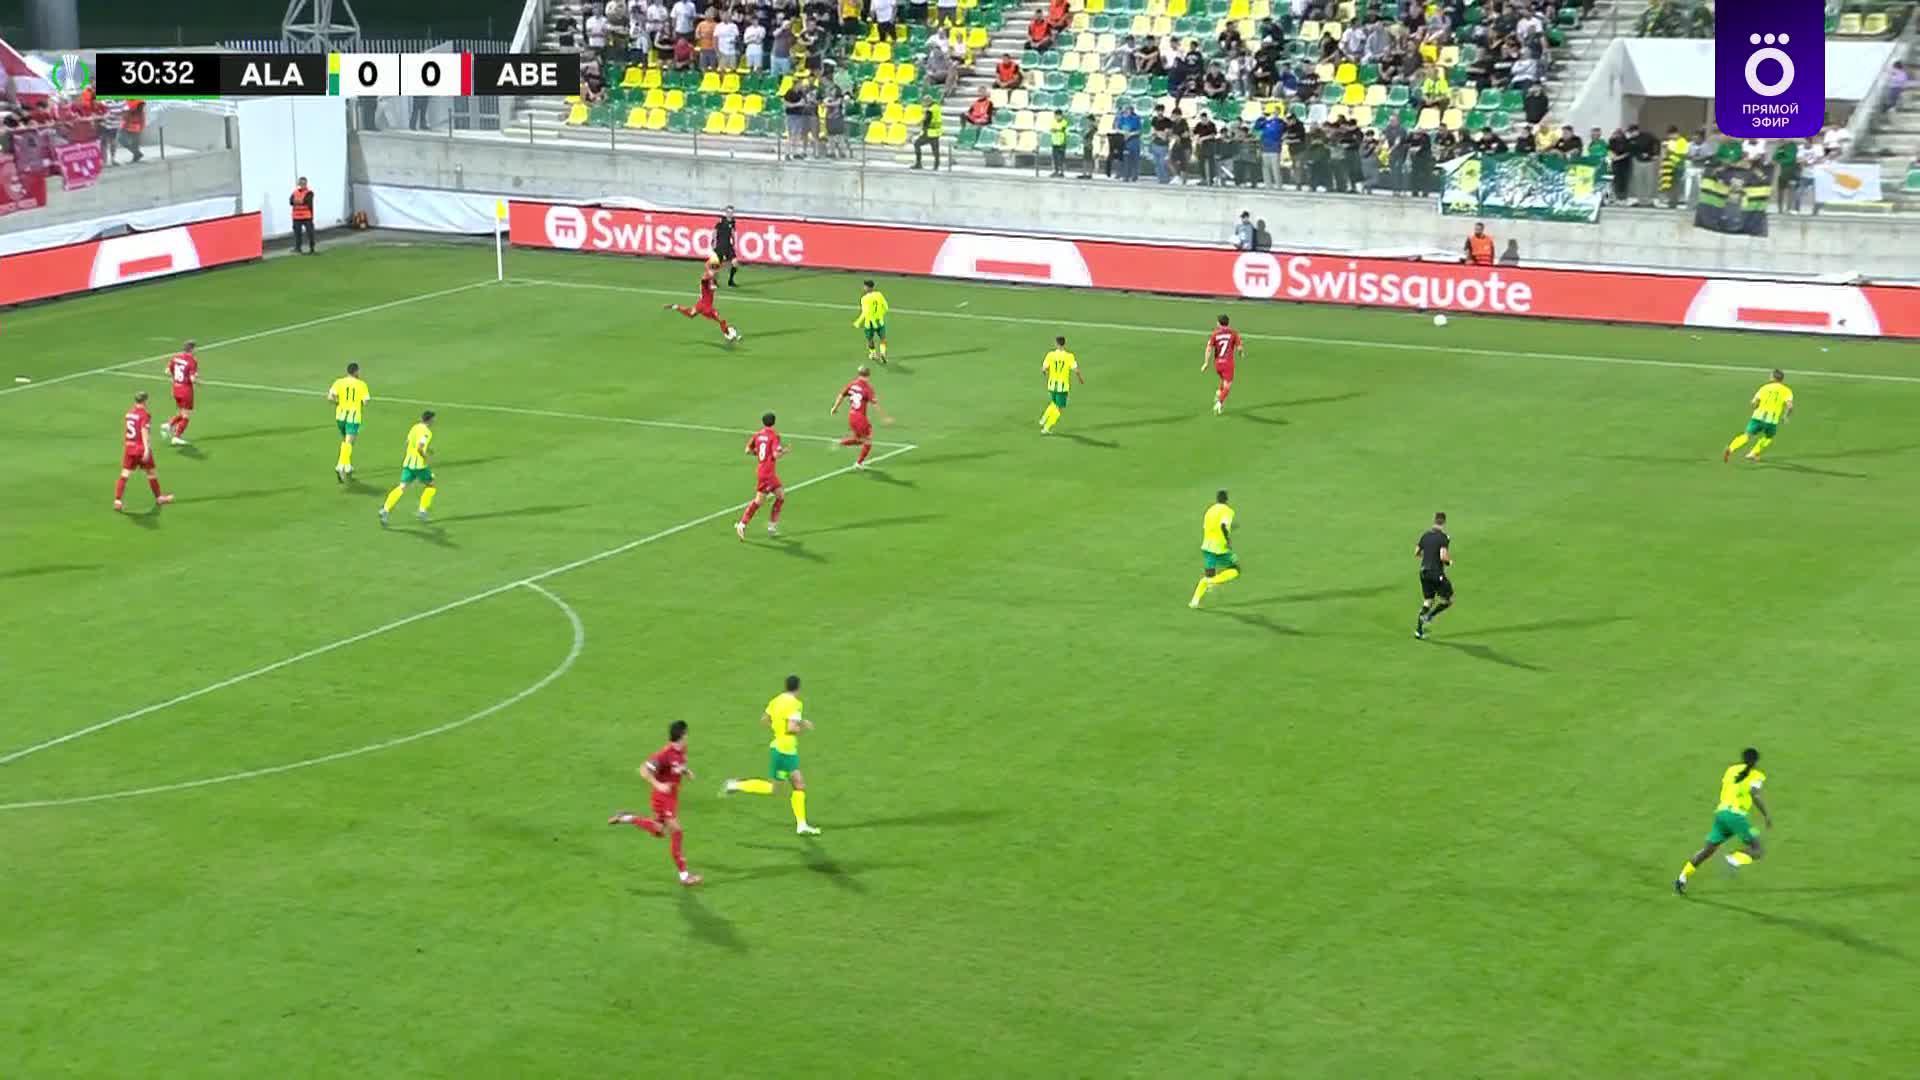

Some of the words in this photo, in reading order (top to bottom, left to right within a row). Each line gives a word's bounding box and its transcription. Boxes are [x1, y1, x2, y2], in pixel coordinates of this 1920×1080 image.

[592, 210, 804, 263] Swissqote
[1287, 257, 1532, 312] Swissquote
[1218, 340, 1229, 357] 7
[126, 420, 136, 439] 5
[759, 443, 766, 461] 8
